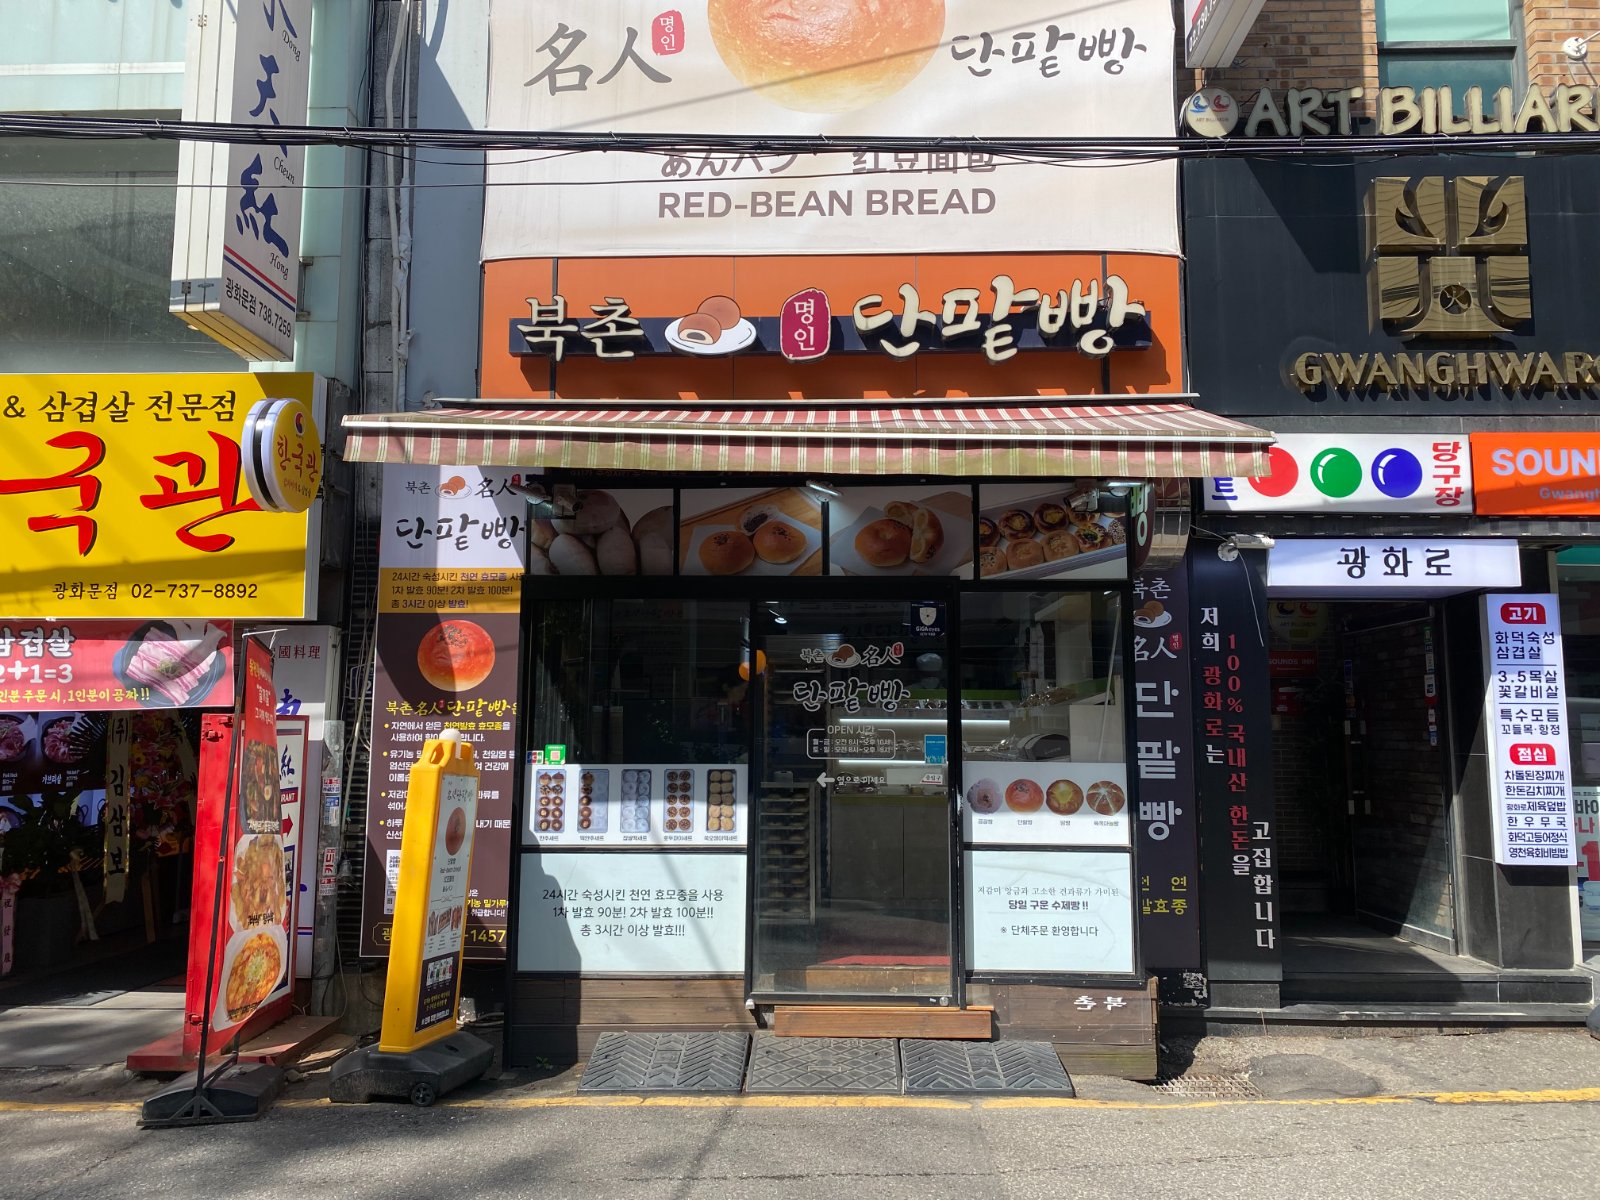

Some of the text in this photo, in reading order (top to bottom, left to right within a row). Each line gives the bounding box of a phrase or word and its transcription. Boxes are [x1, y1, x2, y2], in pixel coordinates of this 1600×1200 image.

[658, 12, 677, 53] 명인
[282, 30, 301, 62] Dong
[950, 24, 1147, 77] 단팥빵
[524, 22, 672, 97] 名人
[1244, 83, 1600, 137] ART BILLIAR
[273, 156, 295, 185] Cheun
[658, 187, 996, 219] RED-BEAN BREAD
[269, 252, 289, 281] Hong
[226, 276, 291, 339] 광화문점 738.7259
[791, 296, 817, 352] 명인
[852, 274, 1147, 365] 단팥빵
[517, 294, 645, 362] 북촌
[1294, 351, 1600, 385] GWANGHWAR
[3, 390, 237, 423] & 삼겹살 전문점
[277, 434, 318, 483] 한국관
[1492, 448, 1600, 476] SOUN
[1432, 441, 1465, 507] 당구장
[405, 481, 431, 495] 북촌
[475, 477, 517, 498] 名人
[396, 513, 525, 551] 단팥빵
[1337, 546, 1453, 579] 광화로
[392, 572, 420, 581] 24시간
[422, 572, 458, 582] 숙성시킨
[460, 572, 478, 582] 천연
[480, 572, 507, 582] 효모종
[52, 582, 258, 602] 광화문점 02-737-8892
[392, 586, 513, 595] 1차 발효 90분! 2차 발효 100분!
[391, 599, 469, 609] 총 3시간 이상 발효!
[1509, 607, 1537, 621] 고기
[1495, 631, 1555, 645] 화덕숙성
[800, 648, 825, 664] 북촌
[861, 645, 901, 667] 名人
[1497, 646, 1541, 660] 삼겹살
[1498, 670, 1558, 684] 3.5목살
[1200, 607, 1224, 764] 저희 광화로는
[1498, 685, 1559, 699] 꽃갈비살
[793, 677, 910, 713] 단팥빵
[386, 701, 413, 717] 북촌
[415, 701, 442, 717] 名人
[1500, 709, 1559, 722] 특수모듬
[391, 722, 511, 731] 자연에서 얻은 천연발효 효모종을
[827, 726, 854, 735] OPEN
[390, 734, 423, 742] 사용하여
[390, 750, 413, 759] 유기농
[482, 750, 507, 759] 천일염
[1227, 634, 1250, 876] 100% 국내산 한돈을
[1518, 747, 1547, 762] 점심
[485, 762, 509, 771] 건강에
[1505, 770, 1565, 781] 차돌된장찌개
[1505, 785, 1566, 797] 한돈김치찌개
[1506, 801, 1567, 812] 광화로제육덮밥
[1508, 832, 1567, 844] 화덕고등어정식
[1509, 847, 1569, 859] 영천육회비빔밥
[1004, 886, 1028, 896] 앙금과
[1032, 887, 1056, 896] 고소한
[1059, 887, 1091, 897] 견과류가
[1252, 821, 1276, 950] 고집합니다
[542, 889, 724, 901] 24시간 숙성시킨 천연 효모종을 사용
[1008, 900, 1027, 910] 당일
[1030, 900, 1049, 910] 구운
[1052, 900, 1080, 910] 수제빵
[553, 908, 714, 919] 1차 발효 90분! 2차 발효 100분!!
[580, 925, 685, 937] 총 3시간 이상 발효!!!
[1011, 925, 1098, 937] 단체주문 환영합니다
